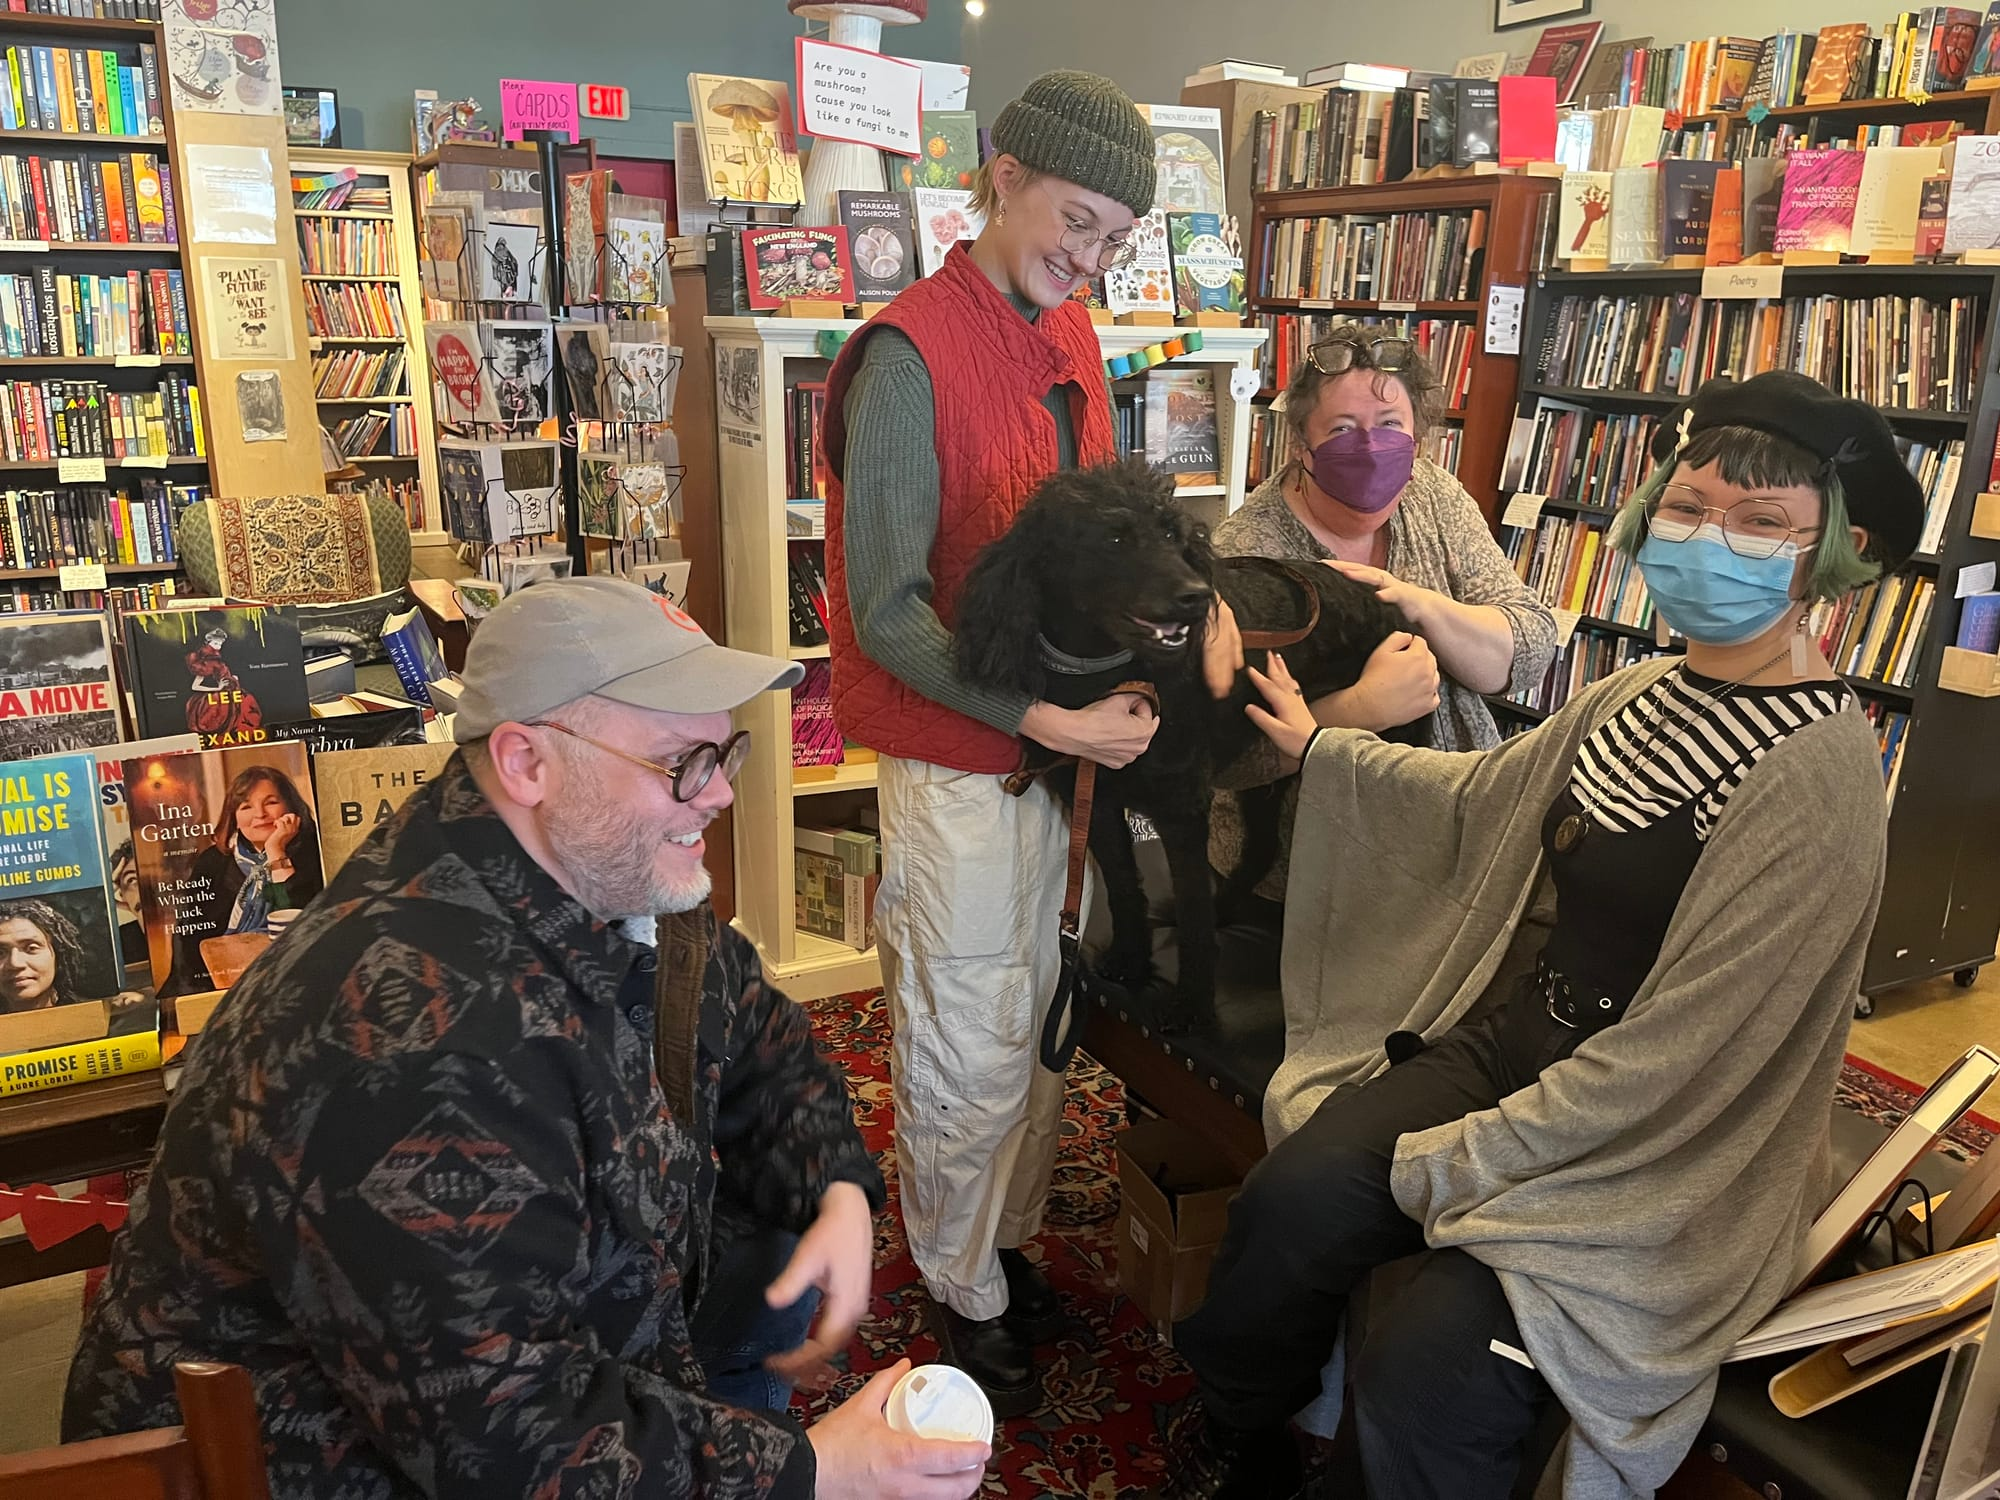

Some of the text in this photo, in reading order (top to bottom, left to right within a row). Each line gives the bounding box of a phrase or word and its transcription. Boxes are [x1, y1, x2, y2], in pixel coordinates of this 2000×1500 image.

[814, 62, 832, 72] Are
[838, 66, 856, 76] you
[814, 79, 866, 95] mushroom?
[515, 92, 570, 120] CARDS
[588, 84, 624, 118] EXIT
[816, 94, 892, 118] Cause you look
[816, 110, 910, 139] like a fungi to me
[780, 166, 798, 184] IS
[850, 202, 900, 210] REMARKABLE
[851, 210, 901, 218] MUSHROOMS
[752, 230, 836, 246] FASCINATING FUNGI
[770, 242, 818, 250] NEW ENGLAND
[1178, 257, 1242, 267] MASSACHUSETTS
[42, 268, 56, 292] neal
[217, 268, 258, 284] PLANT
[1729, 274, 1758, 288] Poetry
[226, 280, 267, 294] FUTURE
[236, 296, 264, 310] WANT
[248, 308, 268, 320] SEE
[42, 294, 59, 355] stephenson
[439, 355, 470, 368] HAPPY
[1180, 453, 1213, 464] GUIN
[0, 684, 108, 718] A MOVE
[208, 690, 242, 706] LEE
[274, 724, 326, 738] My Name Is
[44, 772, 71, 799] IS
[371, 770, 426, 788] THE
[158, 802, 193, 821] Ina
[140, 821, 216, 842] Garten
[27, 840, 50, 851] LIFE
[170, 848, 198, 856] memoir
[14, 852, 48, 866] LORDE
[36, 864, 82, 882] GUMBS
[158, 876, 212, 893] Be Ready
[158, 890, 216, 907] When the
[174, 906, 204, 920] Luck
[164, 918, 217, 936] Happens
[86, 1053, 98, 1075] ALEXIS
[98, 1048, 111, 1075] PAULINE
[112, 1048, 124, 1071] GUMBS
[4, 1055, 78, 1082] PROMISE
[10, 1074, 74, 1092] AUDRE LORDE
